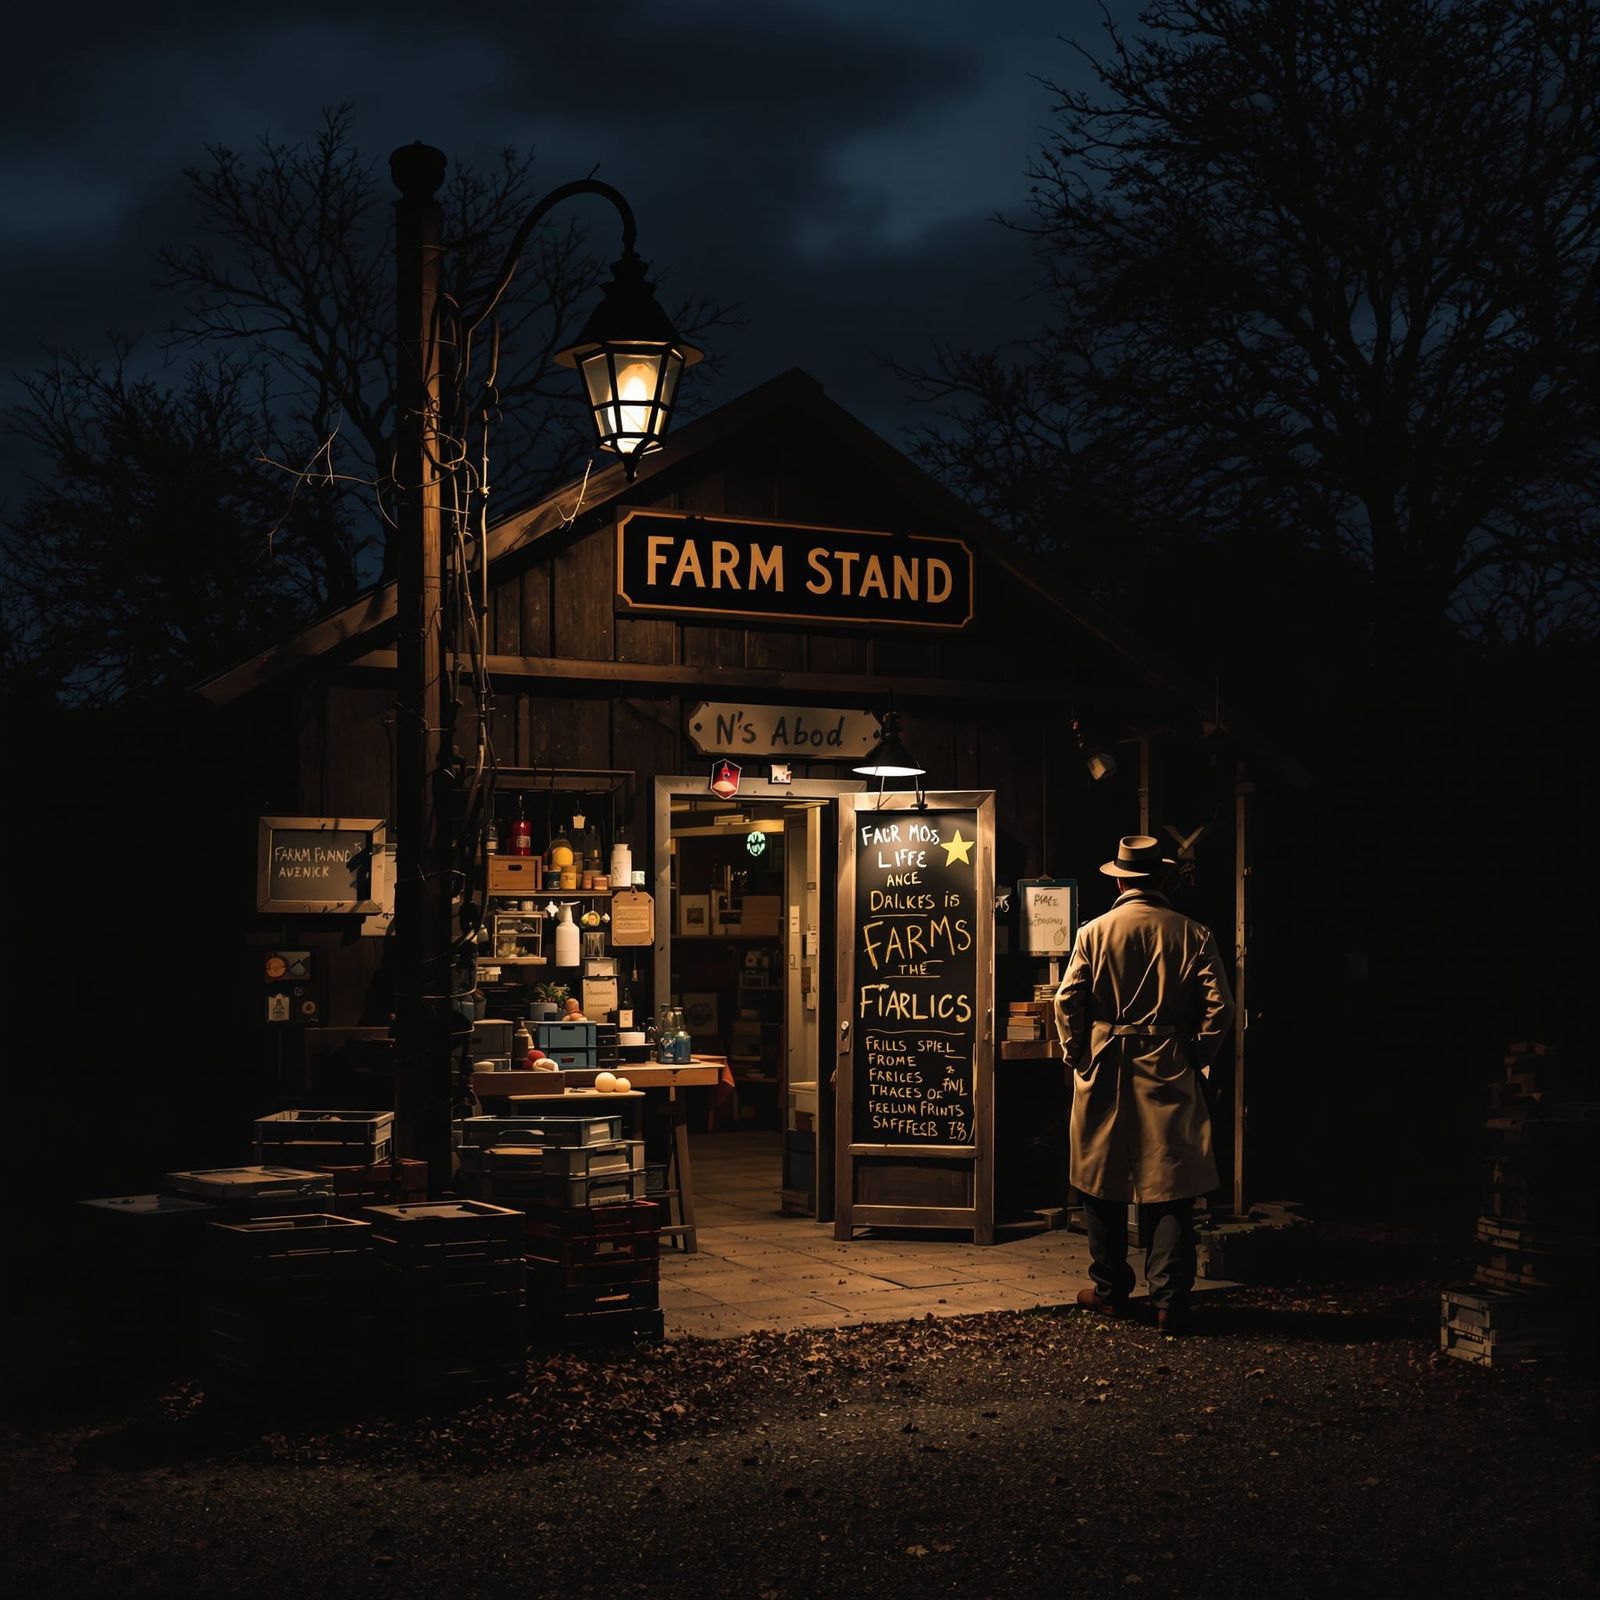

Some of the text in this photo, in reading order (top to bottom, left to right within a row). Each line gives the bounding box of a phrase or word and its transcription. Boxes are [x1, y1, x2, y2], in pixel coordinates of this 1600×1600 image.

[647, 536, 953, 603] FARM STAND
[716, 712, 844, 747] N's Abod
[886, 872, 922, 887] ANCE
[863, 915, 971, 970] FARMS
[898, 963, 928, 975] THE
[865, 1035, 907, 1052] FRILLS
[868, 1053, 917, 1067] FROME
